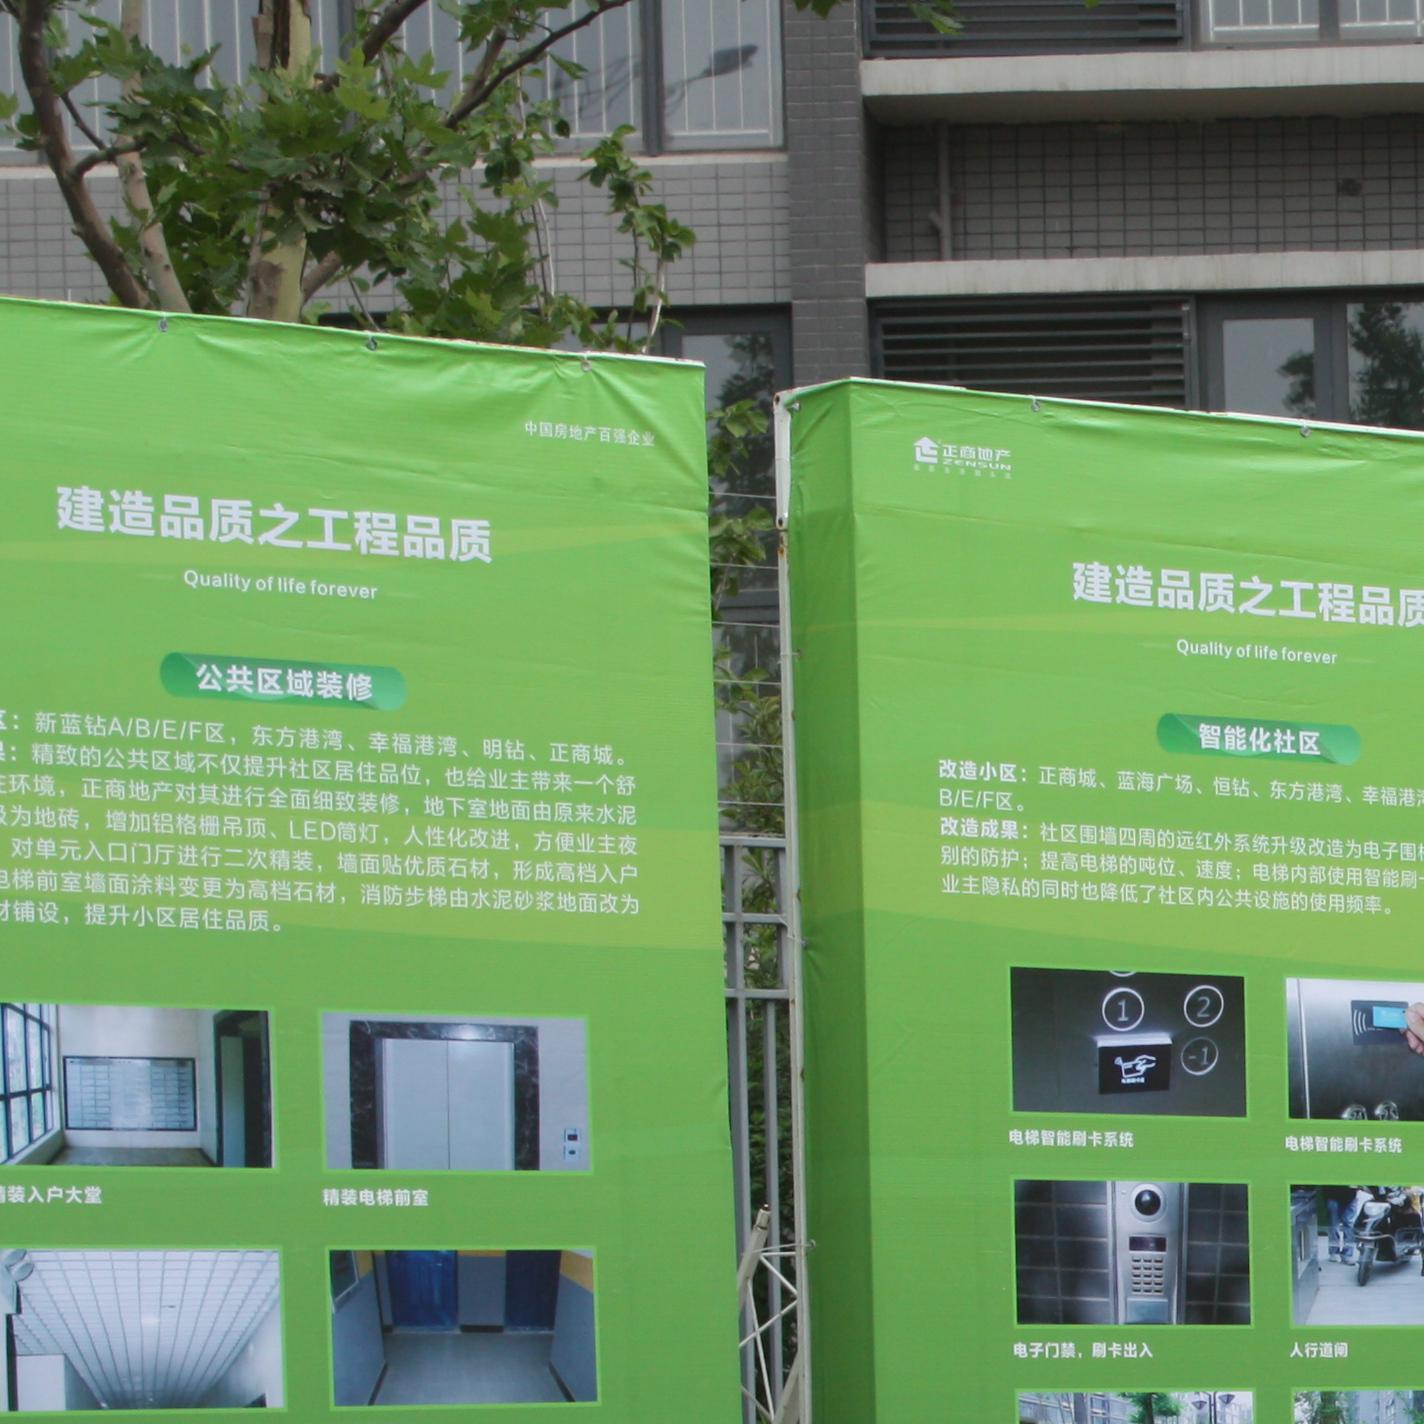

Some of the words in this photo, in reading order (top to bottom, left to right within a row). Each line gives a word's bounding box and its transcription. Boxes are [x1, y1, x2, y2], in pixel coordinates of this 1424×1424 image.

[524, 420, 655, 447] 中国房地产百强企业
[943, 444, 1011, 461] 正商地产
[943, 458, 1012, 471] ZENSUN
[56, 486, 493, 564] 建造品质之工程品质
[184, 569, 251, 593] Quality
[256, 573, 275, 592] of
[278, 576, 306, 595] life
[310, 578, 378, 600] forever
[1176, 637, 1233, 661] Quality
[1235, 641, 1252, 659] of
[1254, 643, 1279, 662] life
[1281, 645, 1338, 665] forever
[195, 664, 373, 701] 公共区域装修
[1198, 722, 1322, 756] 智能化社区
[939, 788, 1025, 813] B/E/F区。
[1117, 999, 1130, 1022] 1
[1196, 996, 1211, 1018] 2
[1008, 1128, 1135, 1149] 电梯智能刷卡系统
[1284, 1134, 1403, 1154] 电梯智能刷卡系统
[322, 1187, 429, 1208] 精装电梯前室
[1013, 1341, 1153, 1360] 电子门禁，刷卡出入
[1290, 1340, 1349, 1359] 人行道闸
